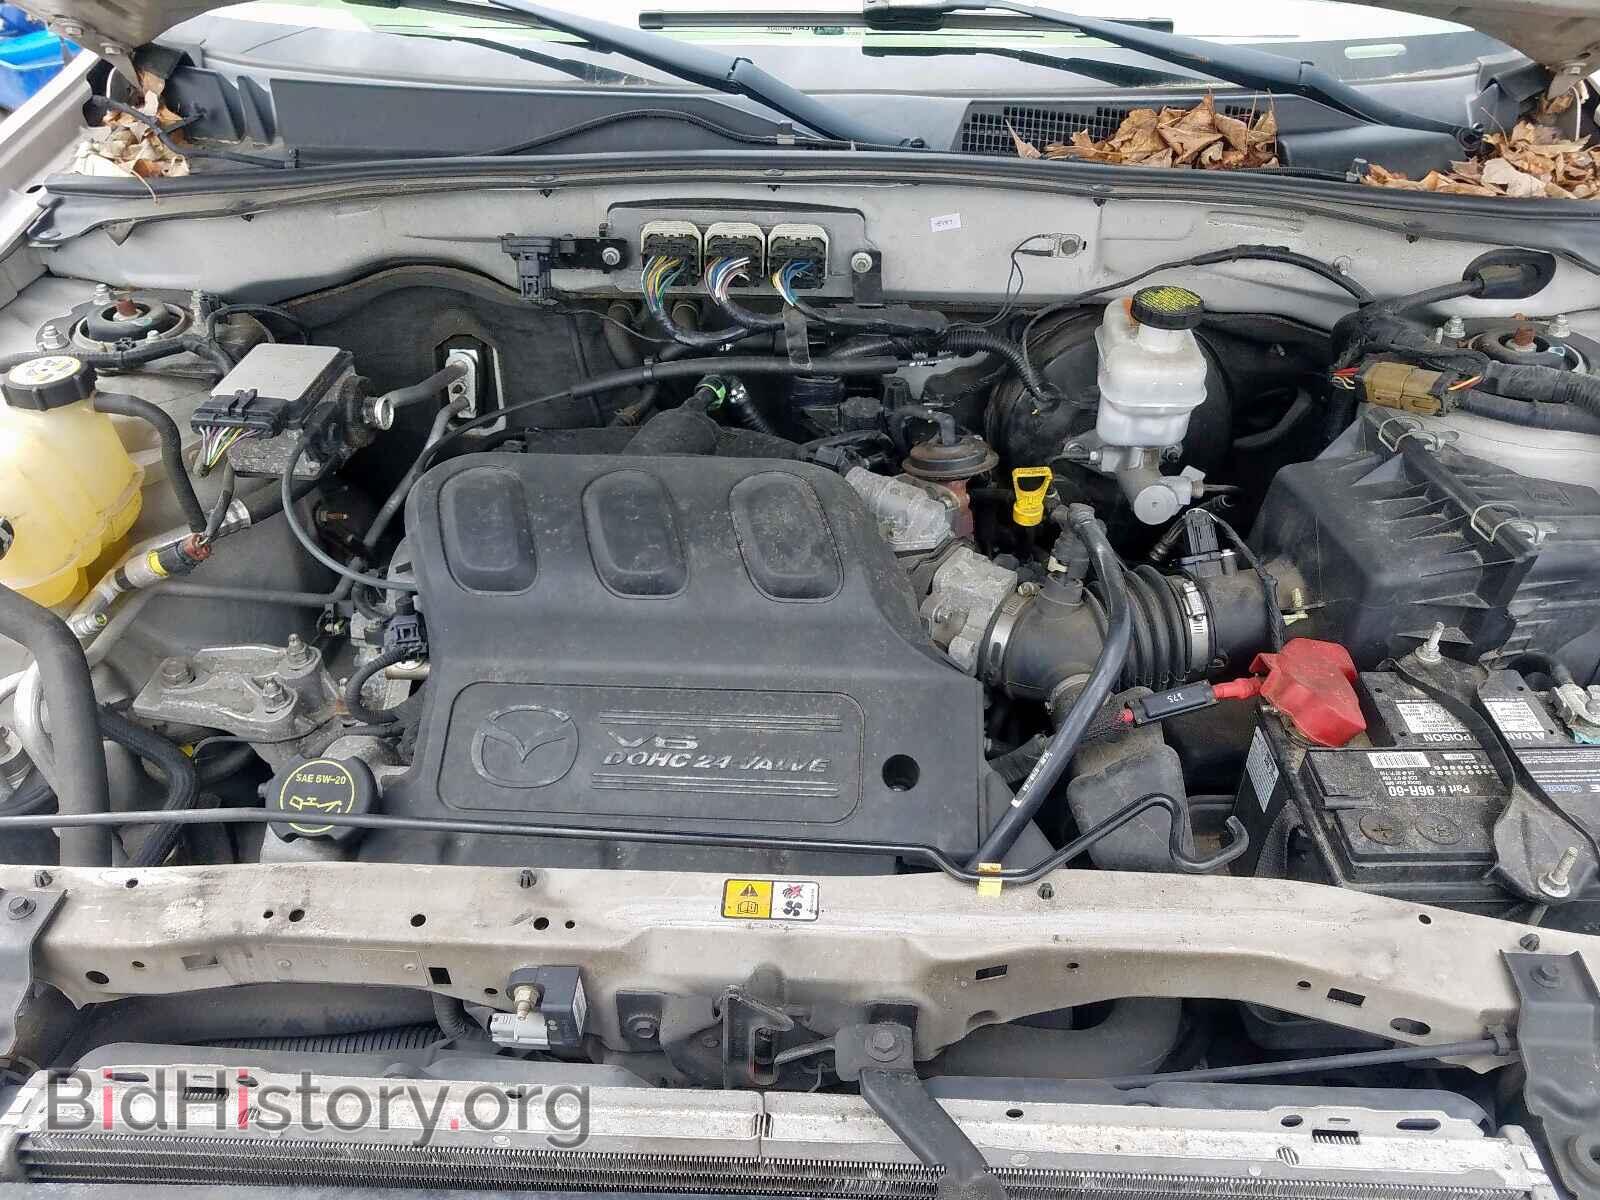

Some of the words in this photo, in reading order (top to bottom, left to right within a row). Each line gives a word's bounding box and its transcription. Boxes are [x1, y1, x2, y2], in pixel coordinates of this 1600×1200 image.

[606, 729, 699, 749] V6
[603, 752, 692, 769] DOHC
[693, 755, 732, 770] 24
[296, 773, 314, 783] SAE
[1449, 784, 1470, 793] Part
